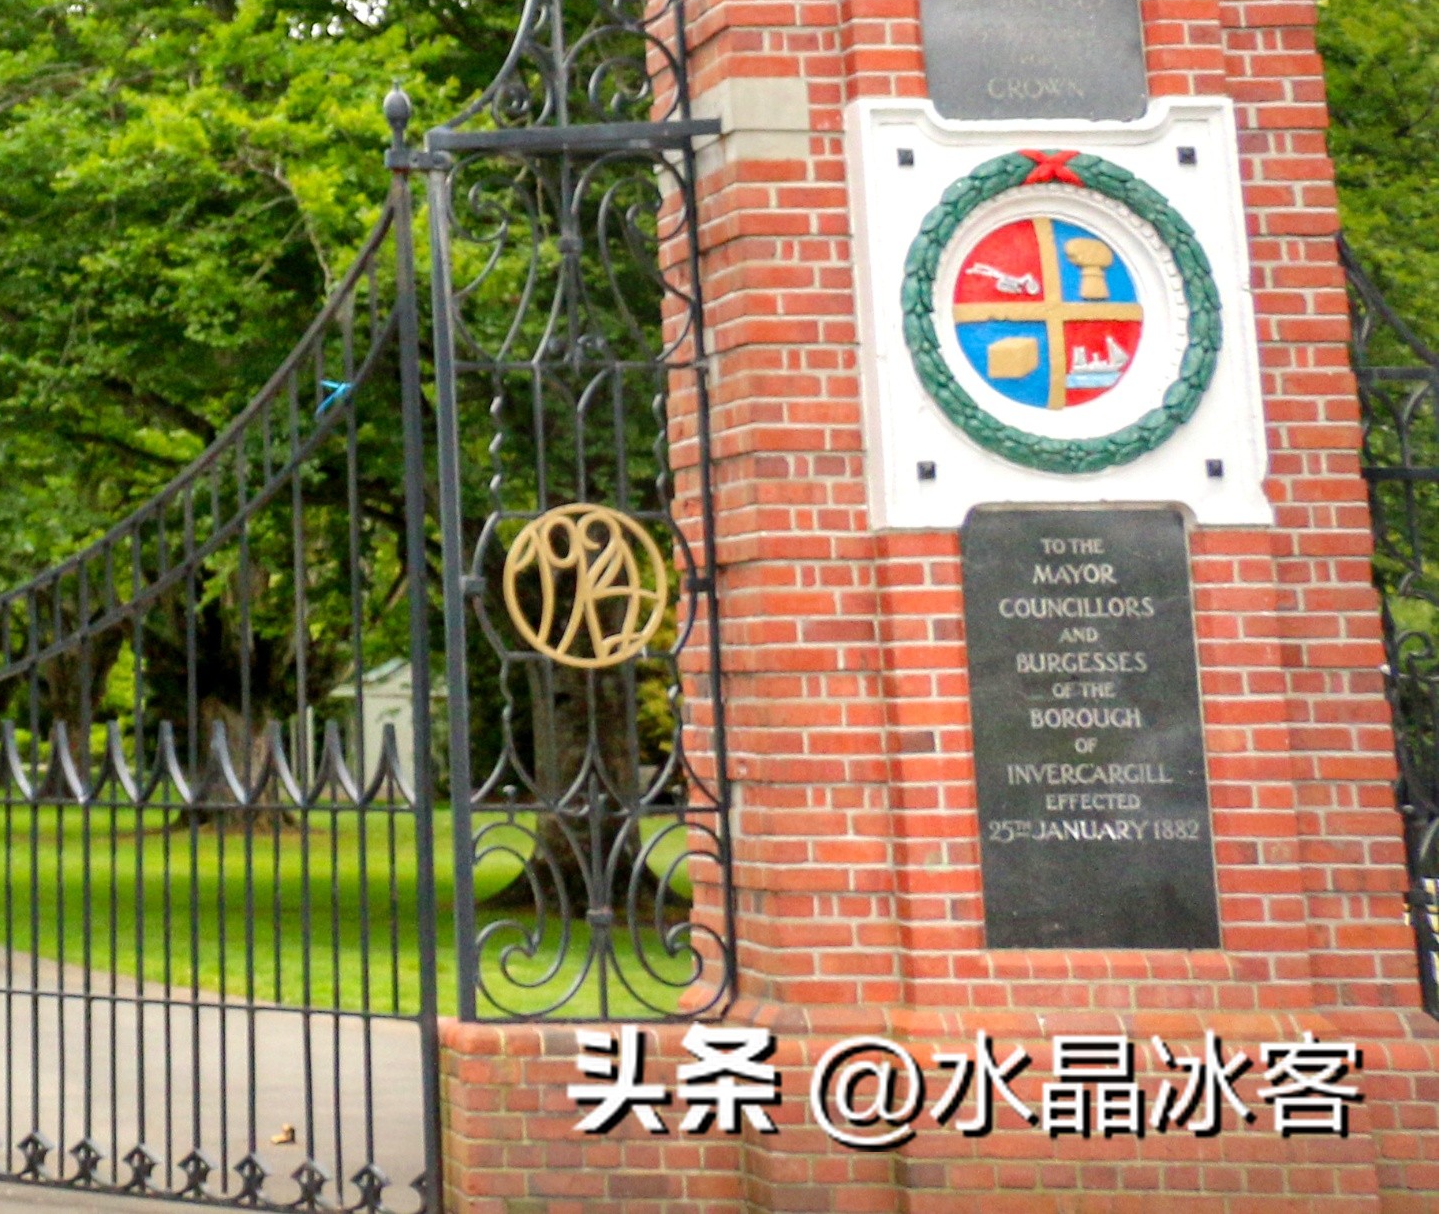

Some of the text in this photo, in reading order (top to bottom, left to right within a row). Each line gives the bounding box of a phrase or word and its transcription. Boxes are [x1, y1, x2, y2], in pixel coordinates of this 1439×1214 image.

[986, 77, 1085, 100] CROWN
[1041, 537, 1105, 555] TO THE
[1032, 563, 1117, 585] MAYOR
[999, 597, 1155, 619] COUNCILLORS
[1059, 627, 1099, 643] AND
[1016, 652, 1147, 674] BURGESSES
[1052, 681, 1116, 699] OF THE
[1030, 707, 1142, 730] BOROUGH
[1075, 737, 1099, 754] OF
[1007, 763, 1173, 785] INVERCARGILL
[1046, 793, 1141, 811] EFFECTED
[1033, 820, 1148, 842] JANUARY
[1152, 818, 1200, 842] 1882
